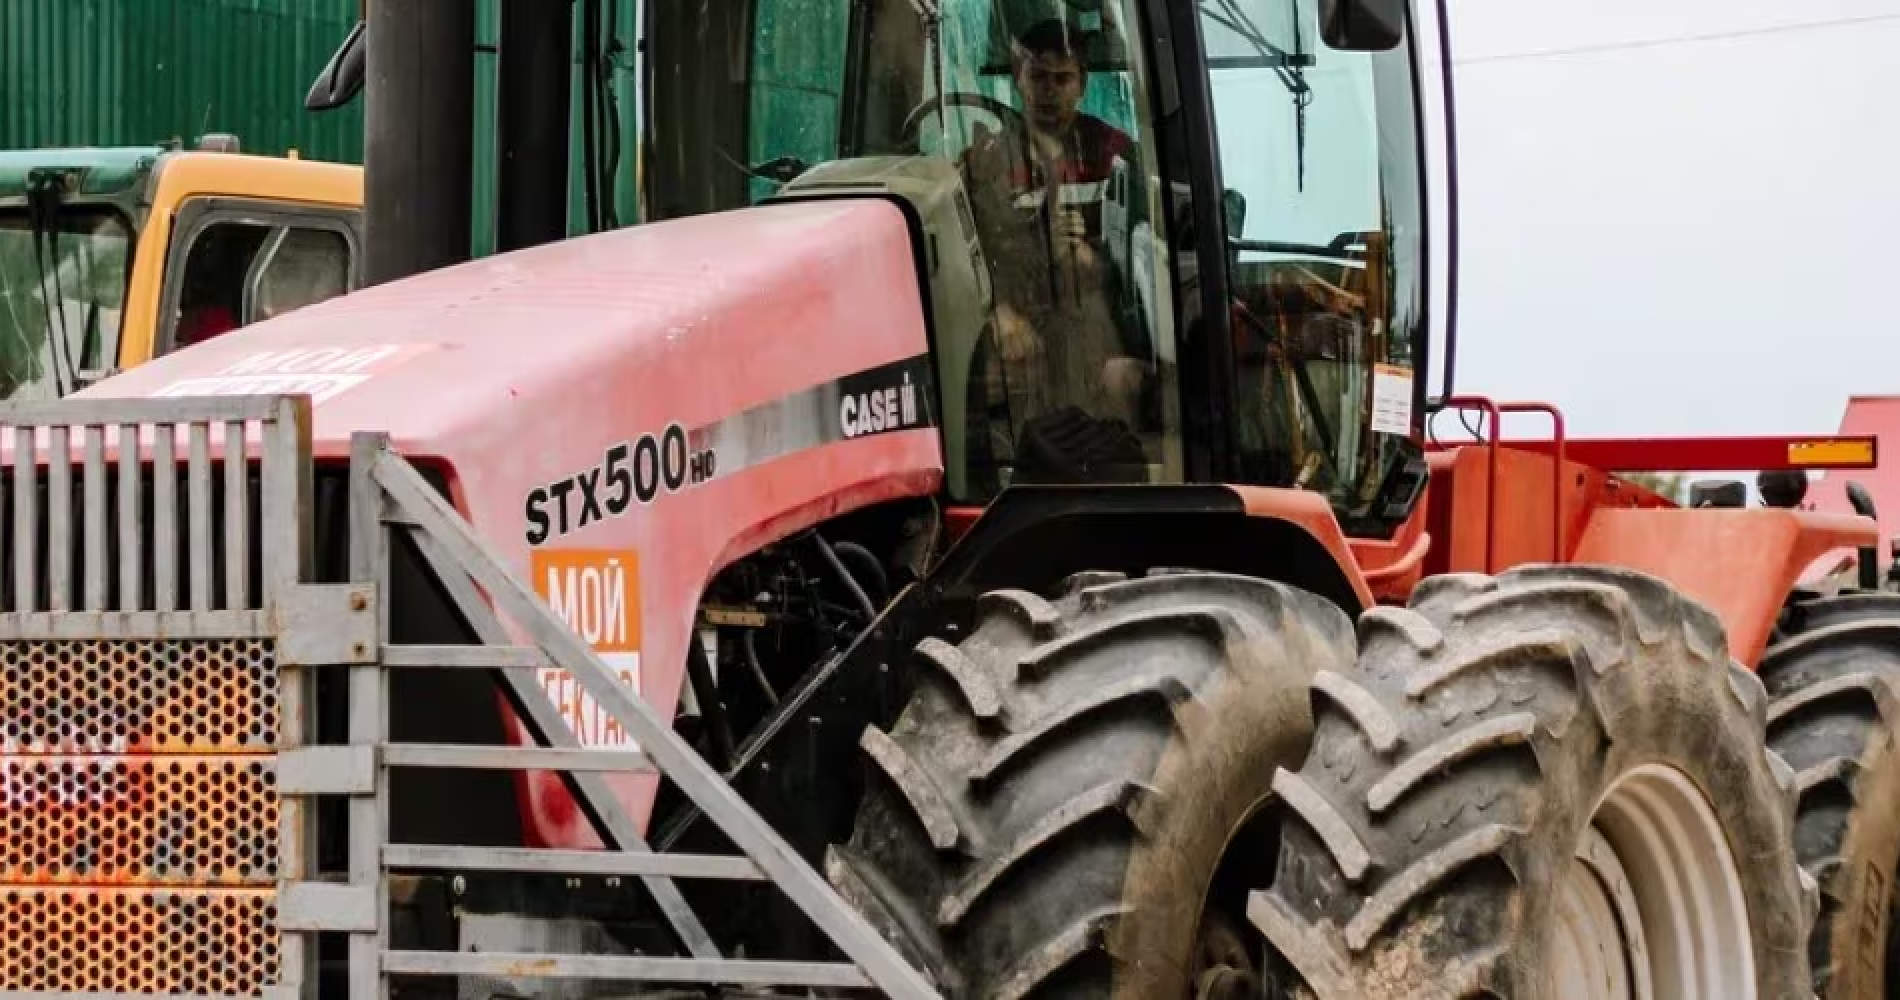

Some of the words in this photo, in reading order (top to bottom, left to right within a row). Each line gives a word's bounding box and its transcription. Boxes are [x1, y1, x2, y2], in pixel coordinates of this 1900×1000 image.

[841, 386, 899, 437] CASE
[525, 423, 687, 545] STX500
[548, 558, 626, 644] МОЙ
